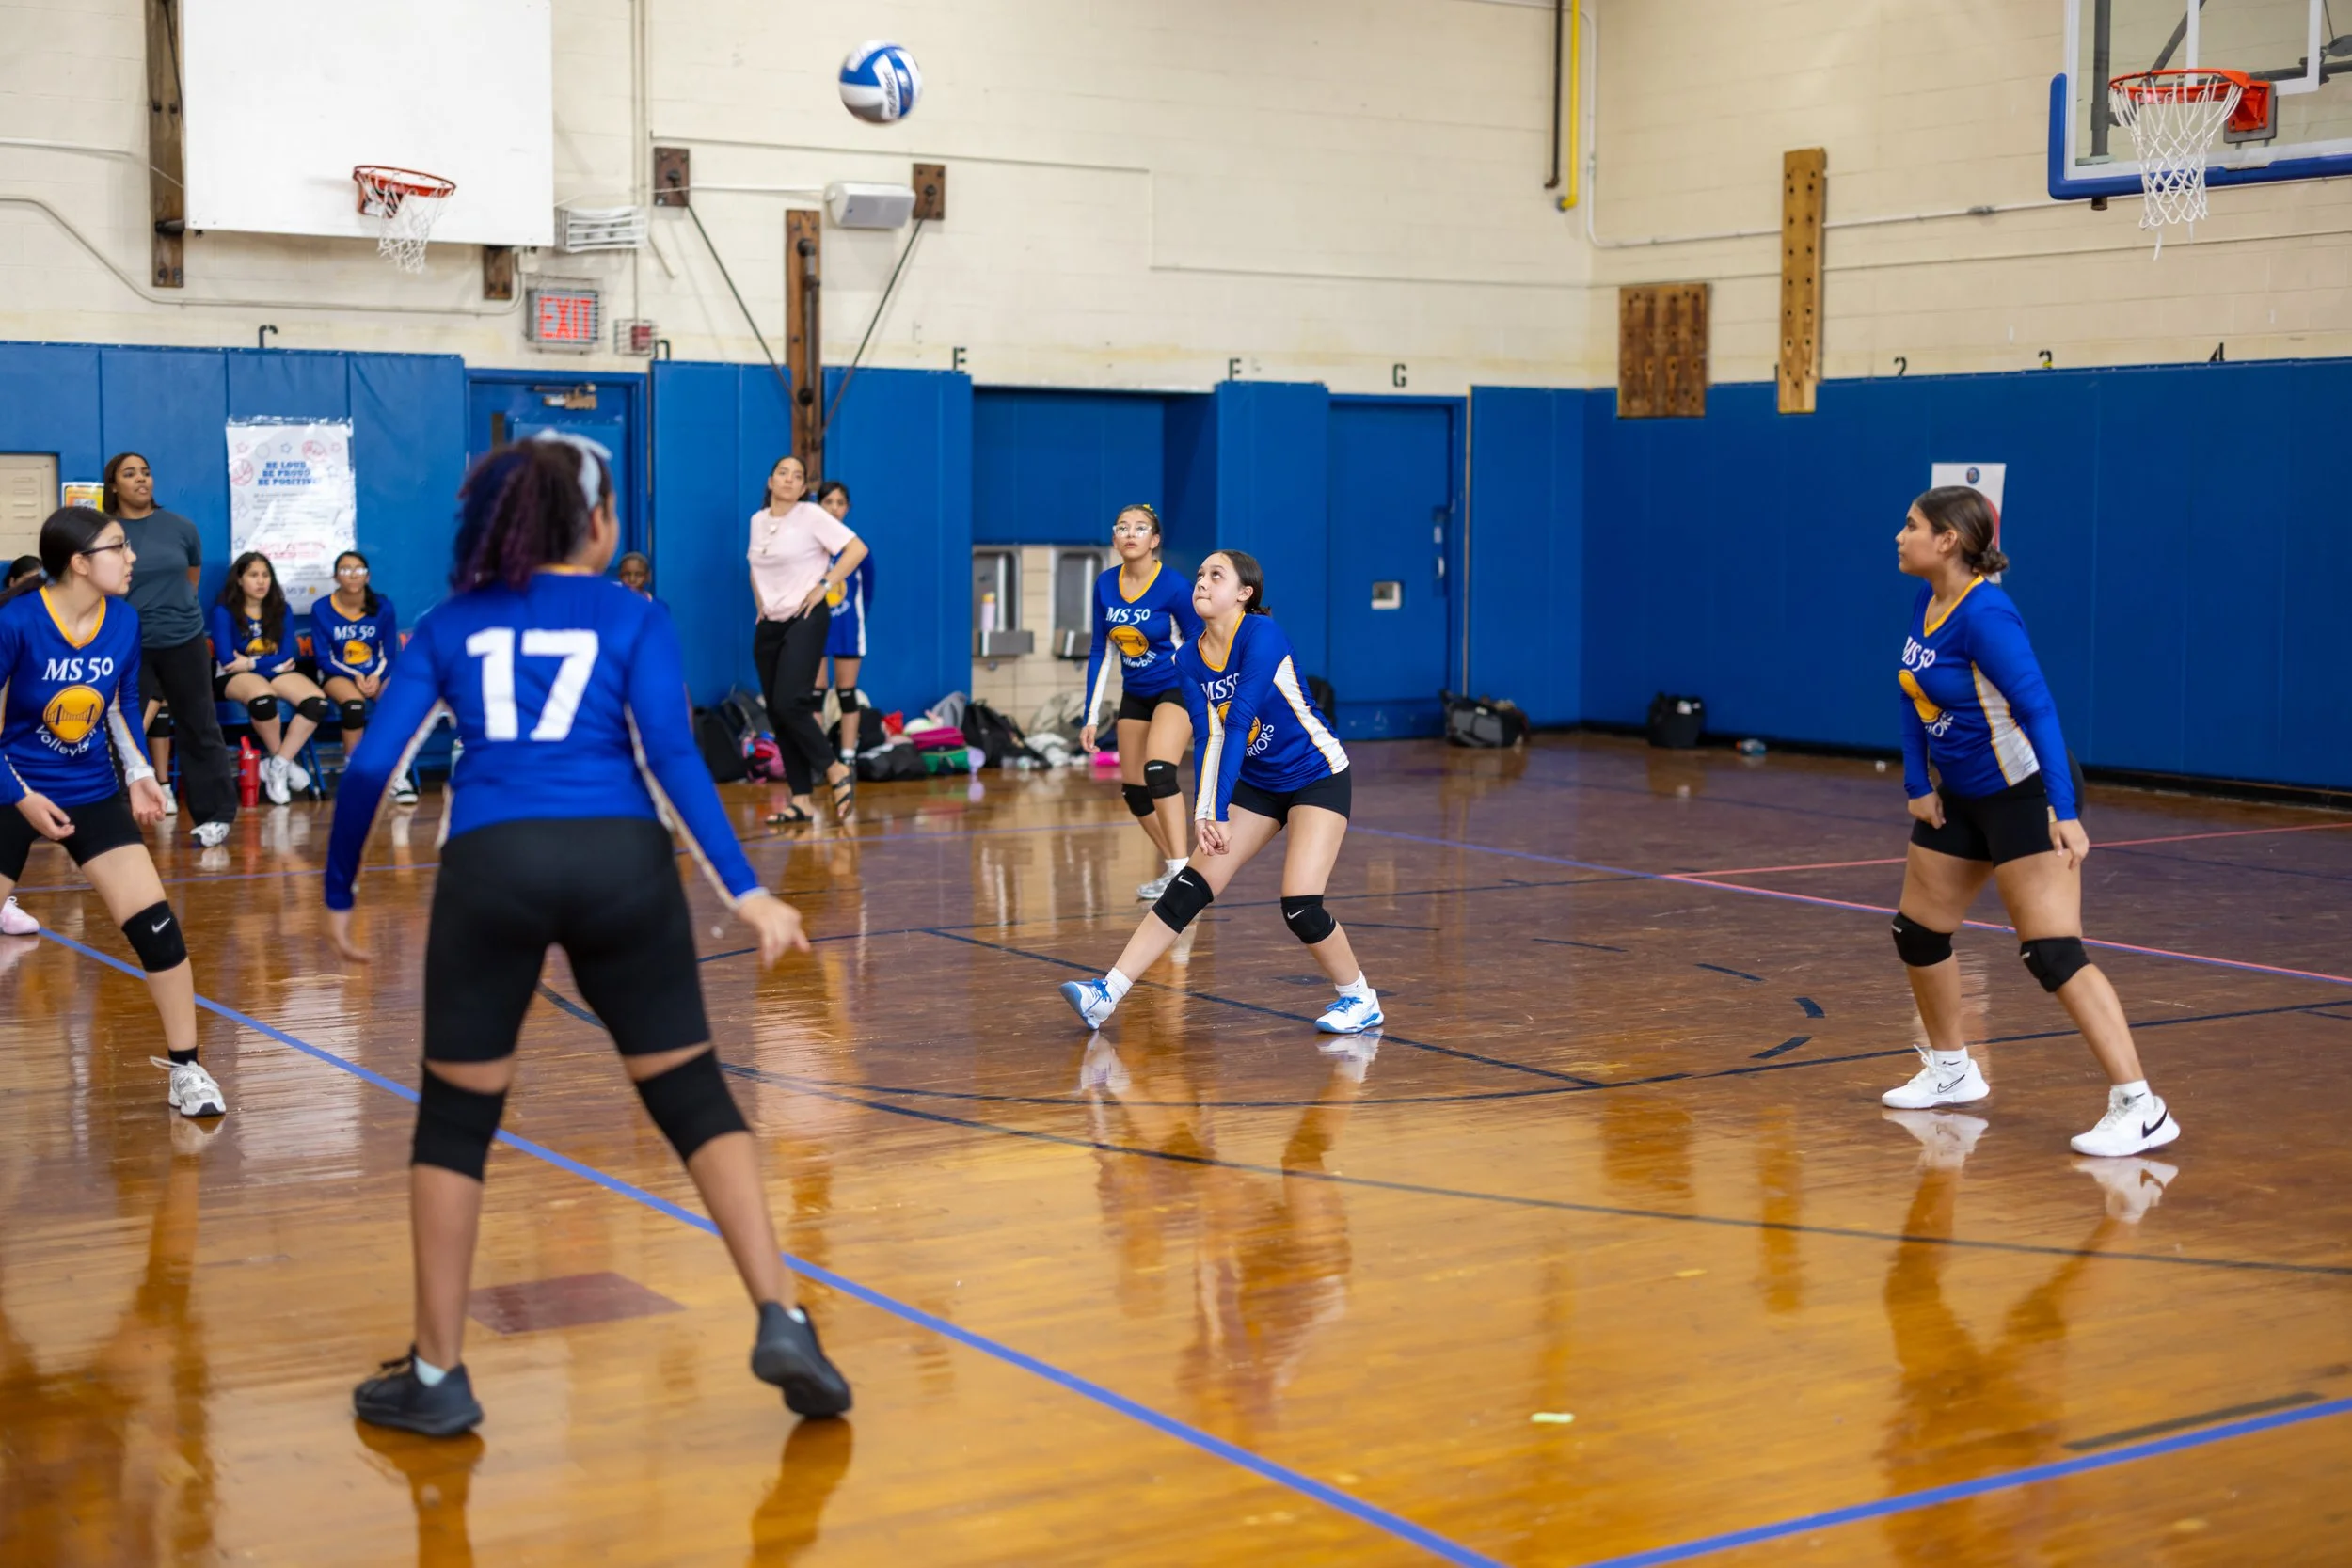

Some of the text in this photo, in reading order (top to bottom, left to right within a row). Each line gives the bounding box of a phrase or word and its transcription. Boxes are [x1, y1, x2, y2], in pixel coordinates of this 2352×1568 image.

[539, 296, 592, 340] EXIT
[1392, 363, 1408, 388] G
[1105, 606, 1151, 626] MS 50
[334, 625, 376, 641] MS 50
[41, 657, 114, 684] MS 50
[1911, 648, 1936, 673] 50
[465, 626, 599, 742] 17
